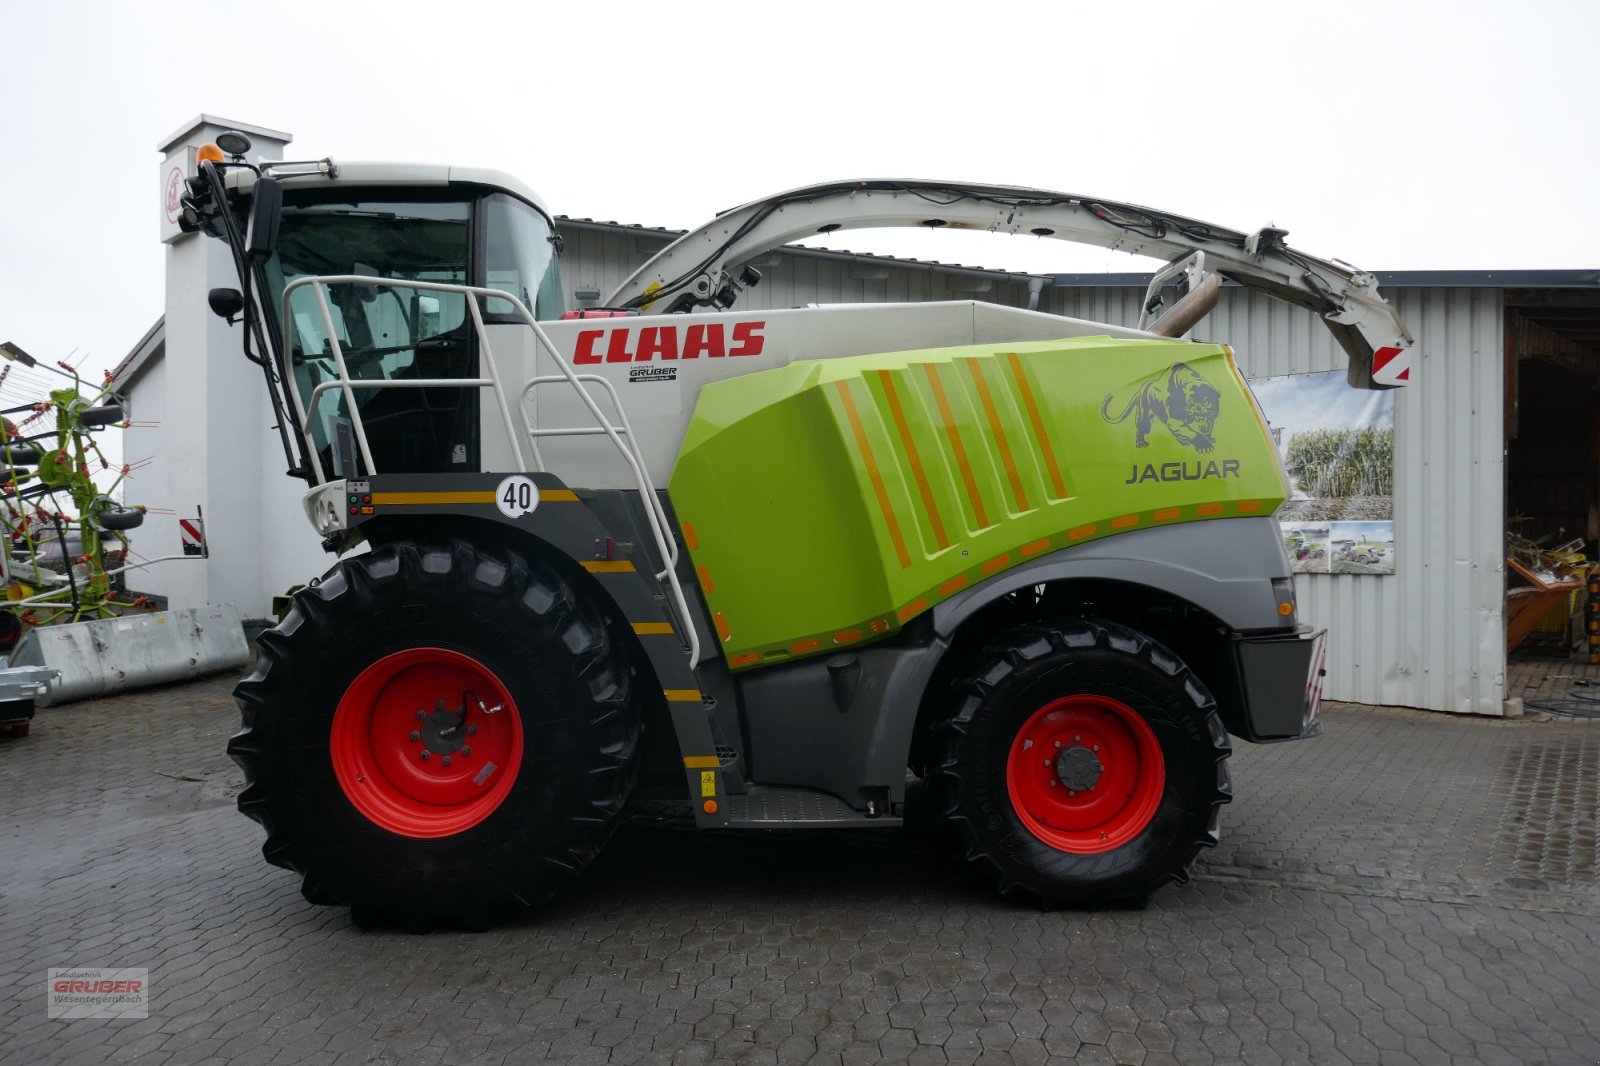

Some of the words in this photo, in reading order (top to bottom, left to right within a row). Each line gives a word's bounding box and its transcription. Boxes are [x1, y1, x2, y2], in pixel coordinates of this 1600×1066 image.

[573, 321, 766, 365] CLAAS
[629, 367, 677, 377] GRUBER
[1125, 459, 1240, 485] JAGUAR
[503, 483, 531, 509] 40
